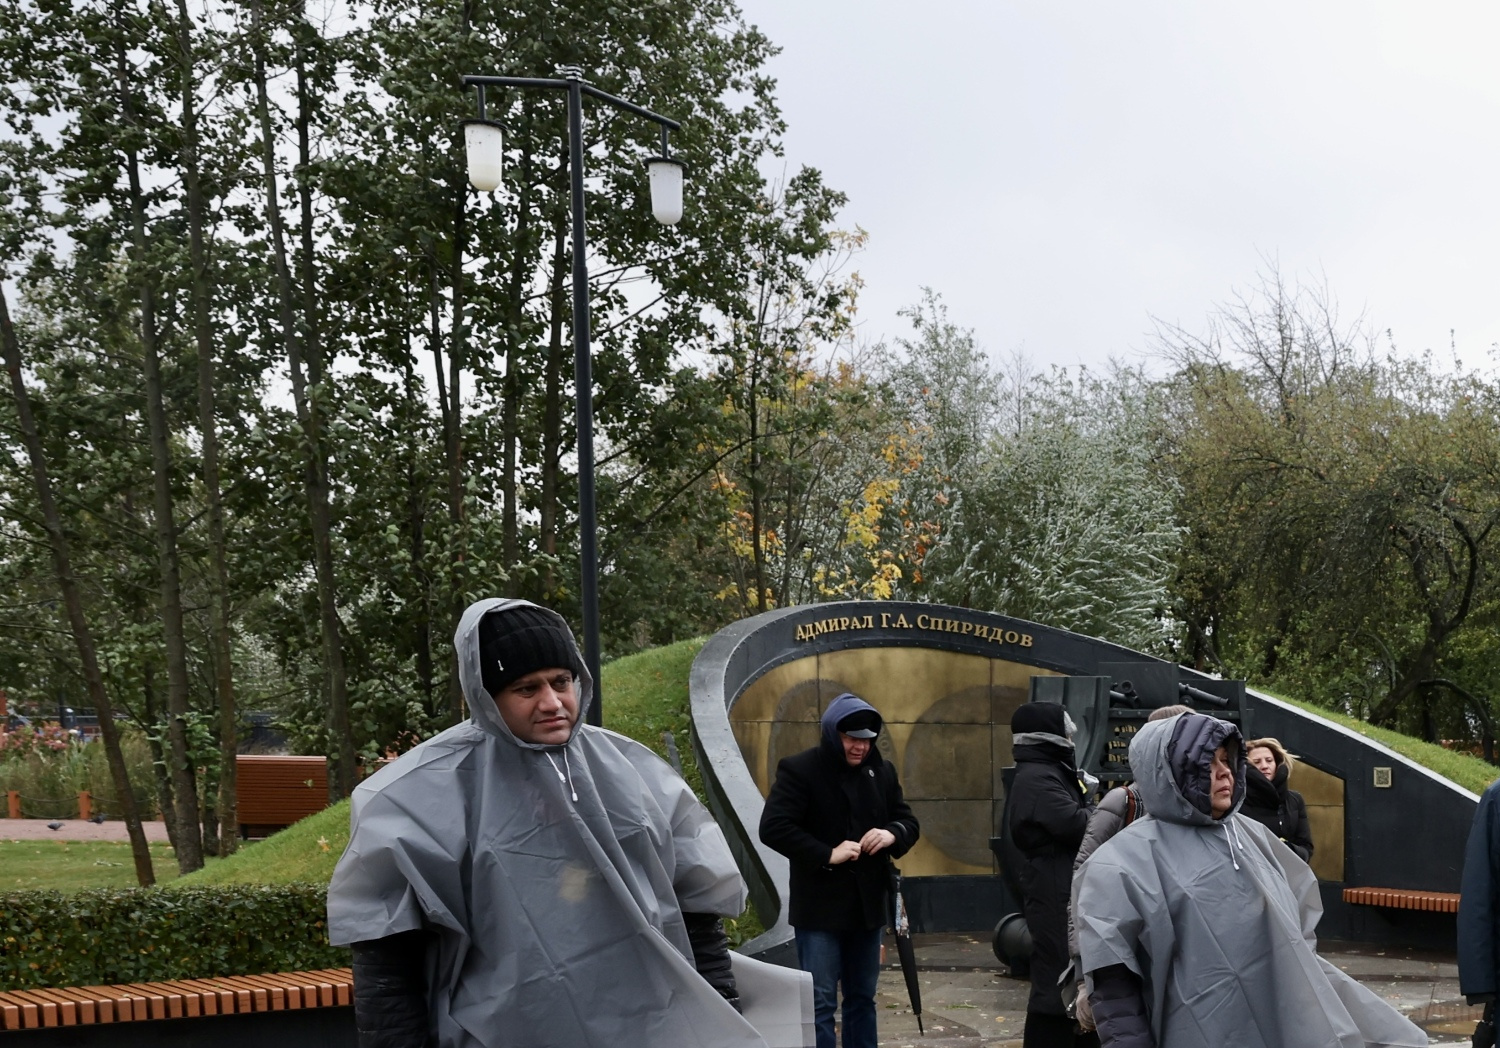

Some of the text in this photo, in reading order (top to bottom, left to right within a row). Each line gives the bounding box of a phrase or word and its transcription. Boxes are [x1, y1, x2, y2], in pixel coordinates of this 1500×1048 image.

[795, 612, 1034, 648] АДМИРАЛ Г.А. СПИРИДОВ
